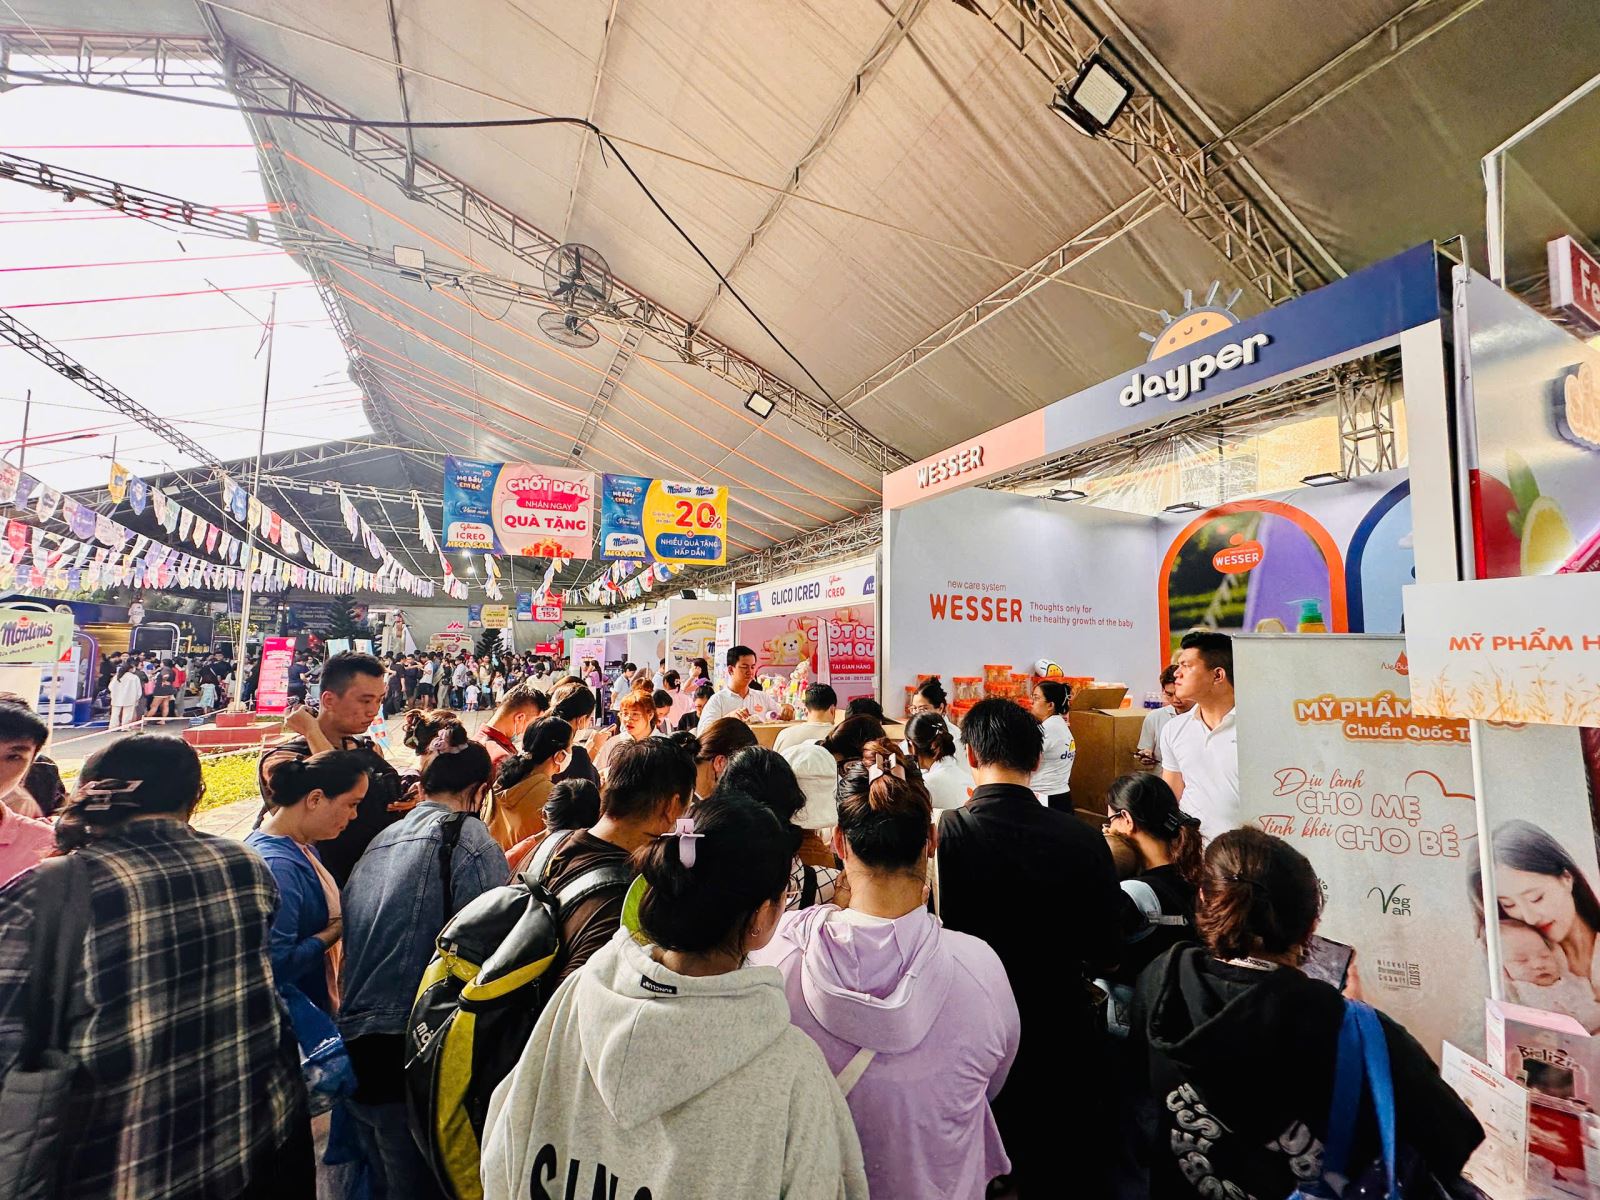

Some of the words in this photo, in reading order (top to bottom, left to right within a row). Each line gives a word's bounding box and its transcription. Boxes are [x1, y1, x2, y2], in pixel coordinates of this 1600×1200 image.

[1119, 333, 1270, 407] dayper
[917, 446, 983, 488] WESSER
[507, 475, 551, 492] CHỐT
[552, 480, 590, 499] DEAL
[504, 513, 540, 528] QUÀ
[544, 515, 586, 532] TẶNG
[676, 500, 722, 529] 20%
[456, 532, 486, 541] ICREO
[1215, 552, 1260, 566] WESSER
[771, 587, 793, 606] GLICO
[795, 581, 820, 602] ICREO
[825, 586, 845, 599] ICREO
[947, 580, 963, 589] new
[963, 582, 980, 590] care
[982, 582, 1007, 592] system
[929, 593, 1022, 623] WESSER
[1029, 601, 1064, 613] Thoughts
[1065, 604, 1081, 614] only
[1082, 605, 1092, 613] for
[0, 620, 53, 647] Montinis
[1029, 615, 1042, 623] the
[1044, 615, 1070, 626] healthy
[1072, 617, 1096, 627] growth
[1098, 618, 1105, 626] of
[1106, 618, 1117, 627] the
[1118, 619, 1134, 629] baby
[1449, 632, 1485, 651] MỸ
[1492, 627, 1573, 651] PHẨM
[1298, 697, 1335, 719] MỸ
[1346, 721, 1403, 738] Chuẩn
[1406, 723, 1453, 739] Quốc
[1273, 768, 1323, 796] Dịu
[1329, 768, 1364, 790] lành
[1296, 790, 1363, 816] CHO
[1371, 794, 1422, 828] MẸ
[1301, 816, 1333, 838] khôi
[1335, 824, 1411, 854] CHO
[1418, 824, 1460, 857] BÉ
